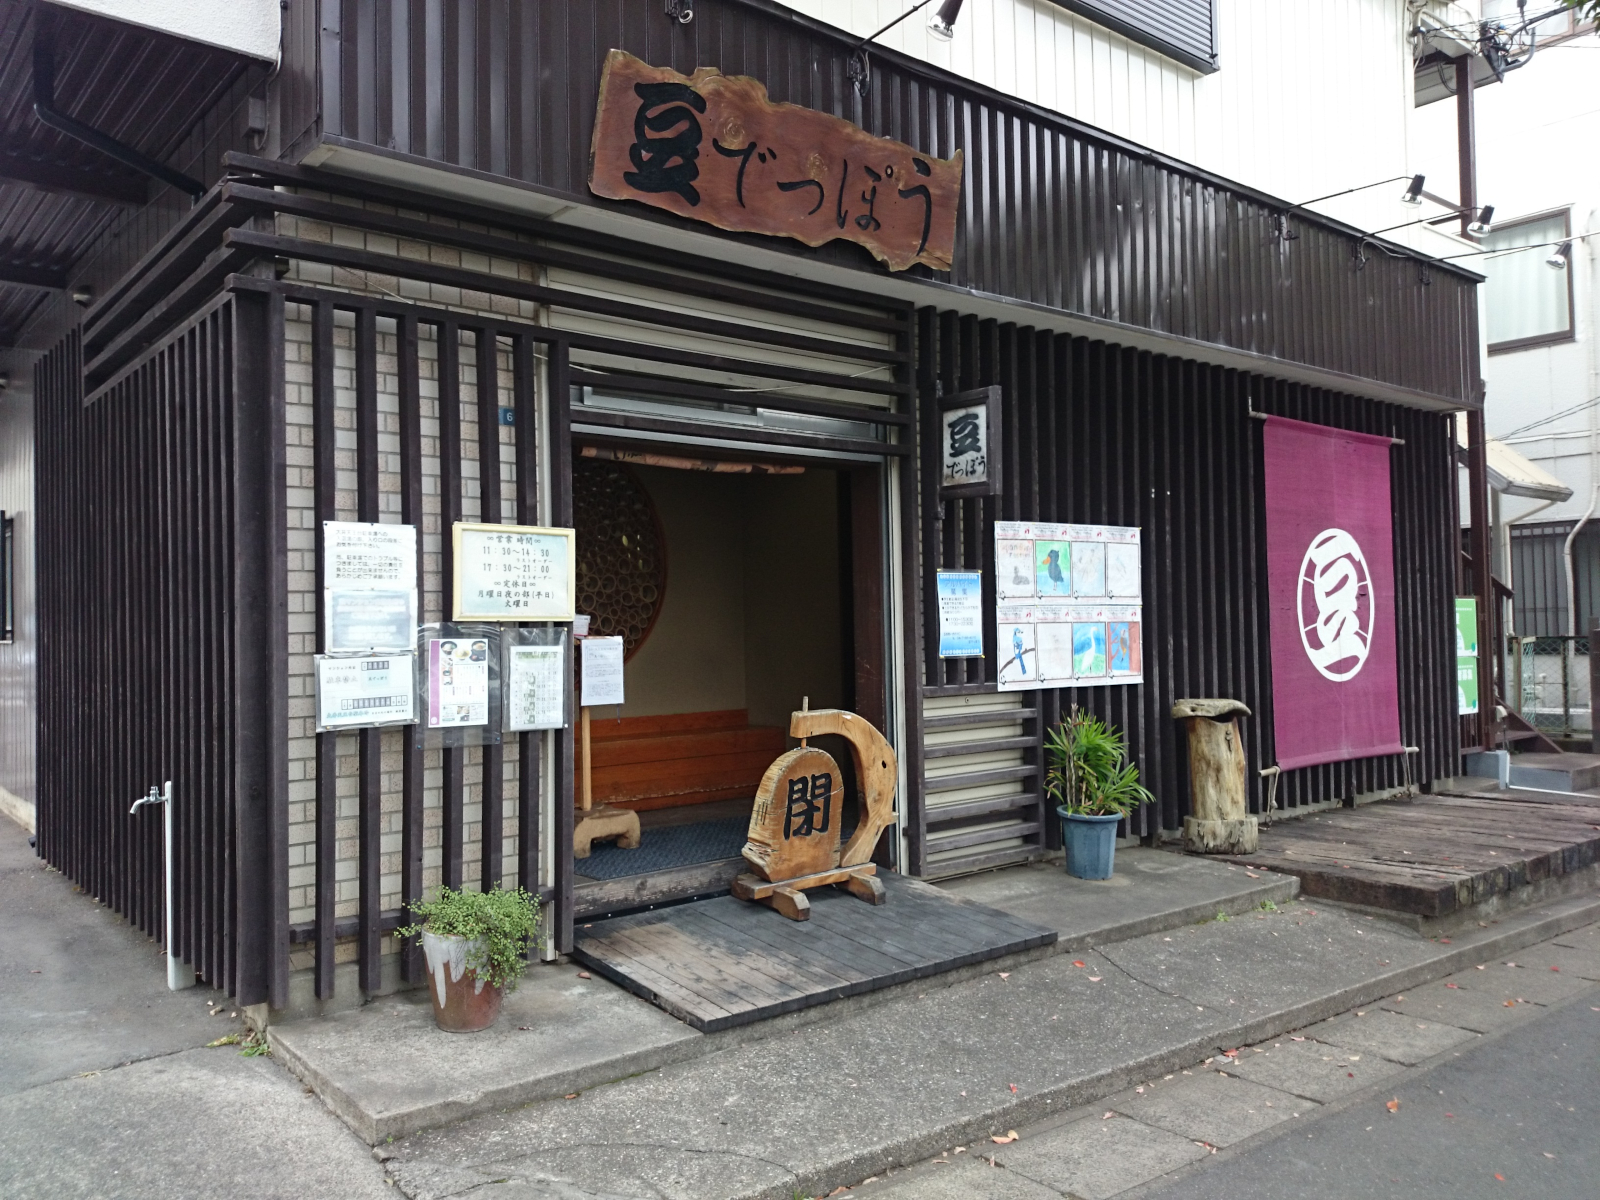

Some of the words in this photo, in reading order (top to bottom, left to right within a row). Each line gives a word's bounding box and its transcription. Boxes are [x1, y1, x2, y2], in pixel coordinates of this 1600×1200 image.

[624, 82, 932, 256] 豆でっぽう
[506, 411, 514, 422] 6
[948, 413, 982, 458] 豆
[504, 599, 529, 608] 火曜日
[782, 772, 833, 842] 閉
